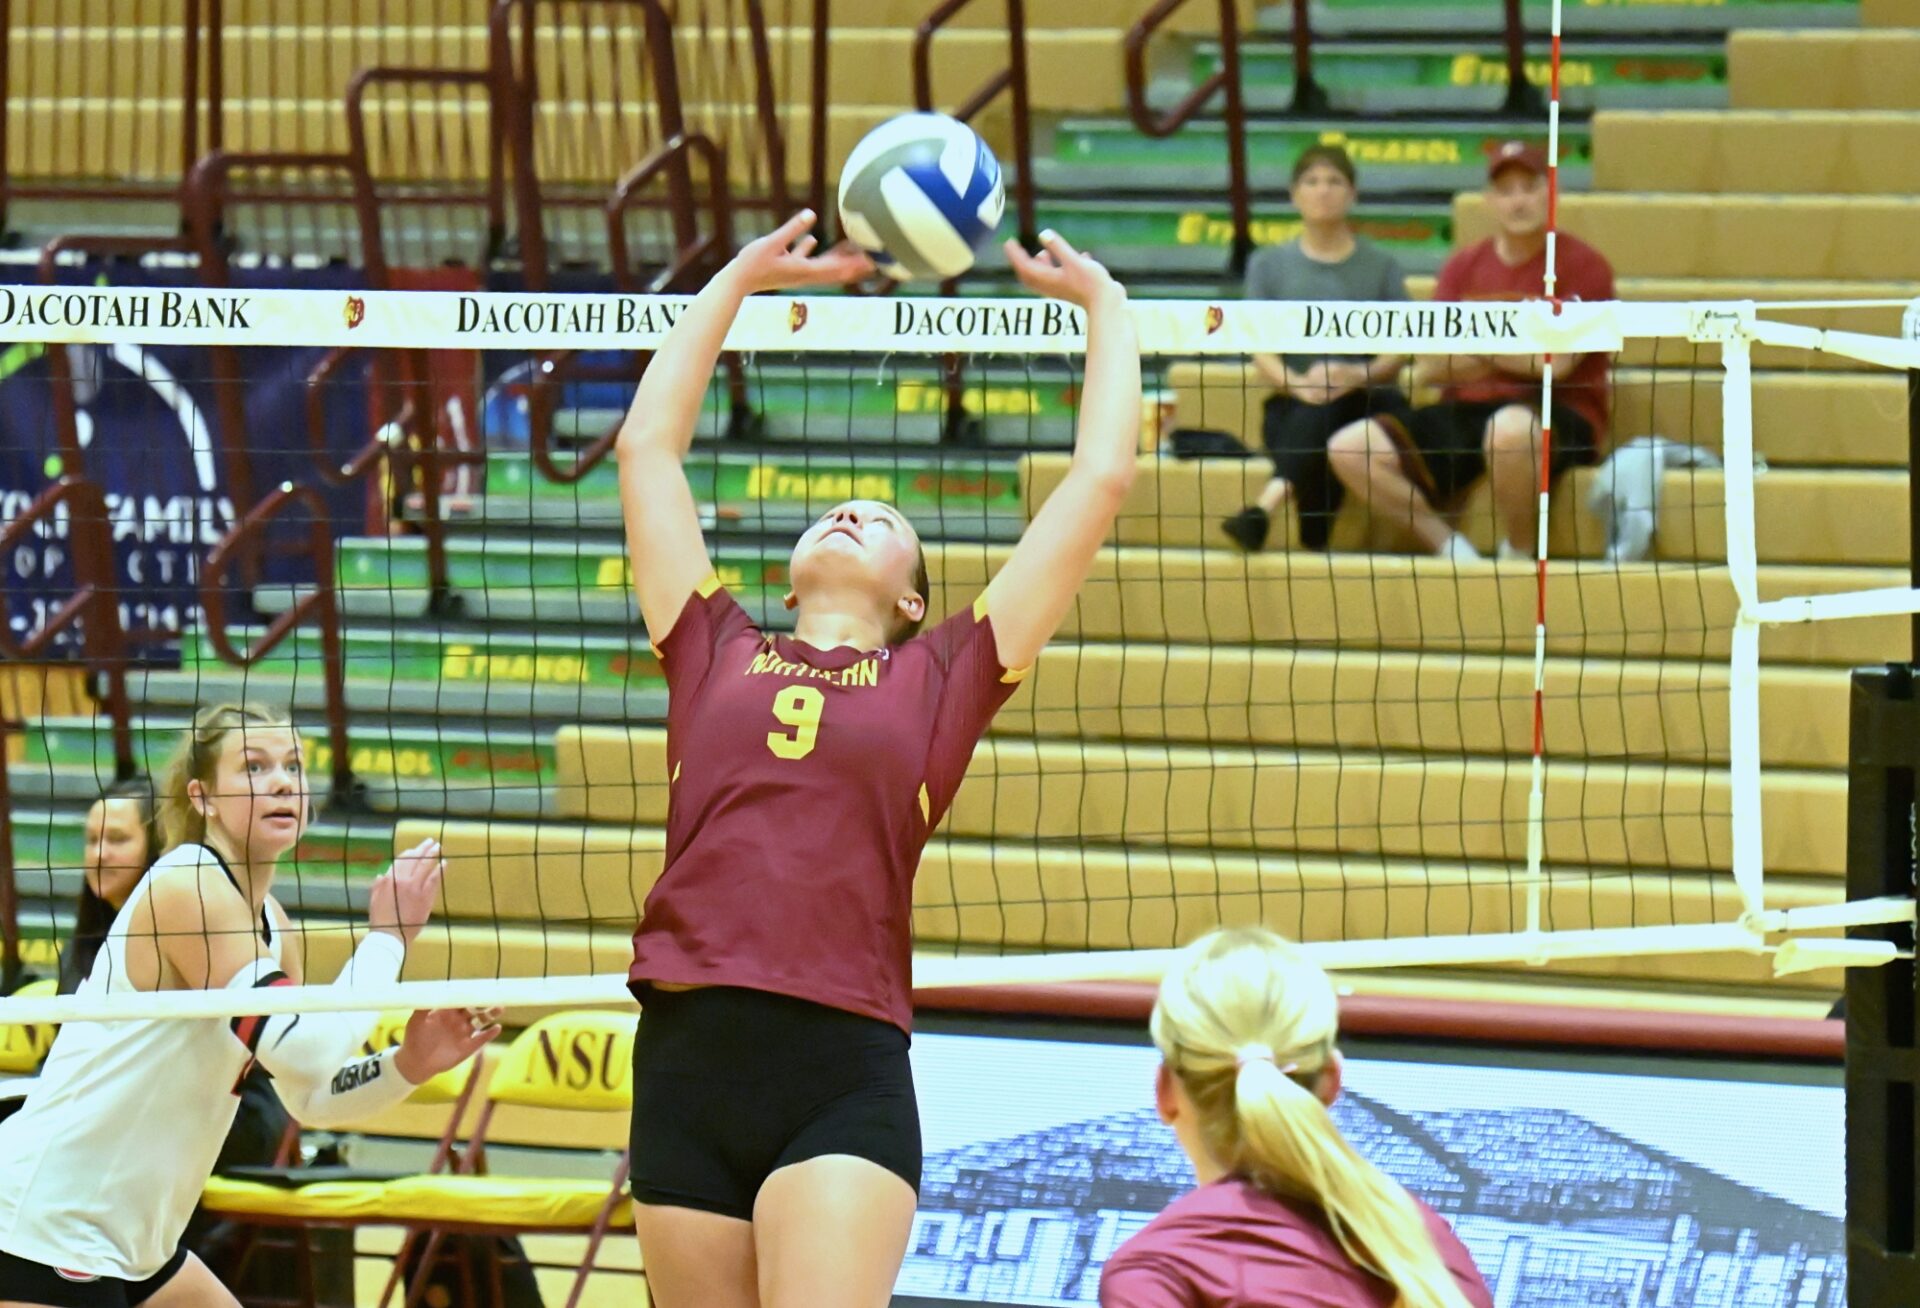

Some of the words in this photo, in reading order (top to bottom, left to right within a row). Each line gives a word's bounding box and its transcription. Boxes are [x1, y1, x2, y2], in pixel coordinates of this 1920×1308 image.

[0, 288, 150, 327] DACOTAH
[158, 292, 250, 328] BANK
[456, 297, 605, 333] DACOTAH
[616, 299, 687, 333] BAN
[893, 301, 1032, 336] DACOTAH
[1041, 303, 1085, 336] BA
[1303, 306, 1435, 338] DACOTAH
[1445, 306, 1518, 338] BANK
[767, 684, 825, 760] 9
[302, 737, 432, 775] TANOL
[525, 1029, 632, 1092] NSU
